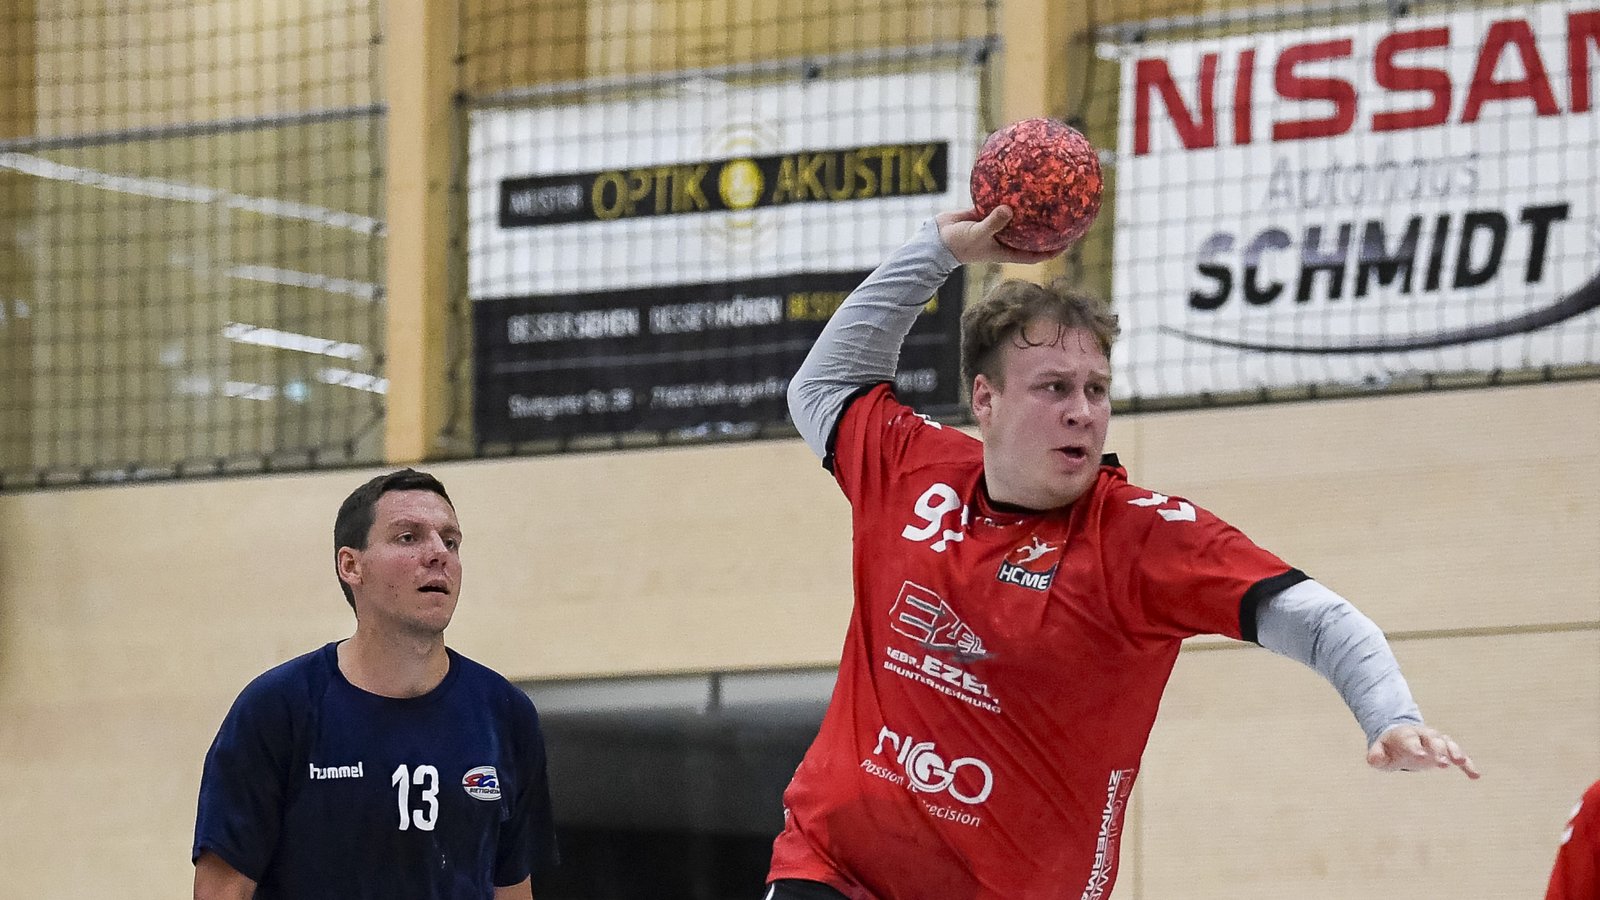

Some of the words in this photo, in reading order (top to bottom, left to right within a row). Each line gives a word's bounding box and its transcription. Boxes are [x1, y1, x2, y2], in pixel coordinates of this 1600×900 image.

[592, 164, 710, 220] OPTIK
[772, 144, 938, 205] AKUSTIK
[1188, 203, 1570, 311] SCHMIDT
[999, 564, 1051, 591] HCME
[309, 761, 364, 780] hummel
[859, 758, 904, 786] Passion
[391, 763, 440, 831] 13
